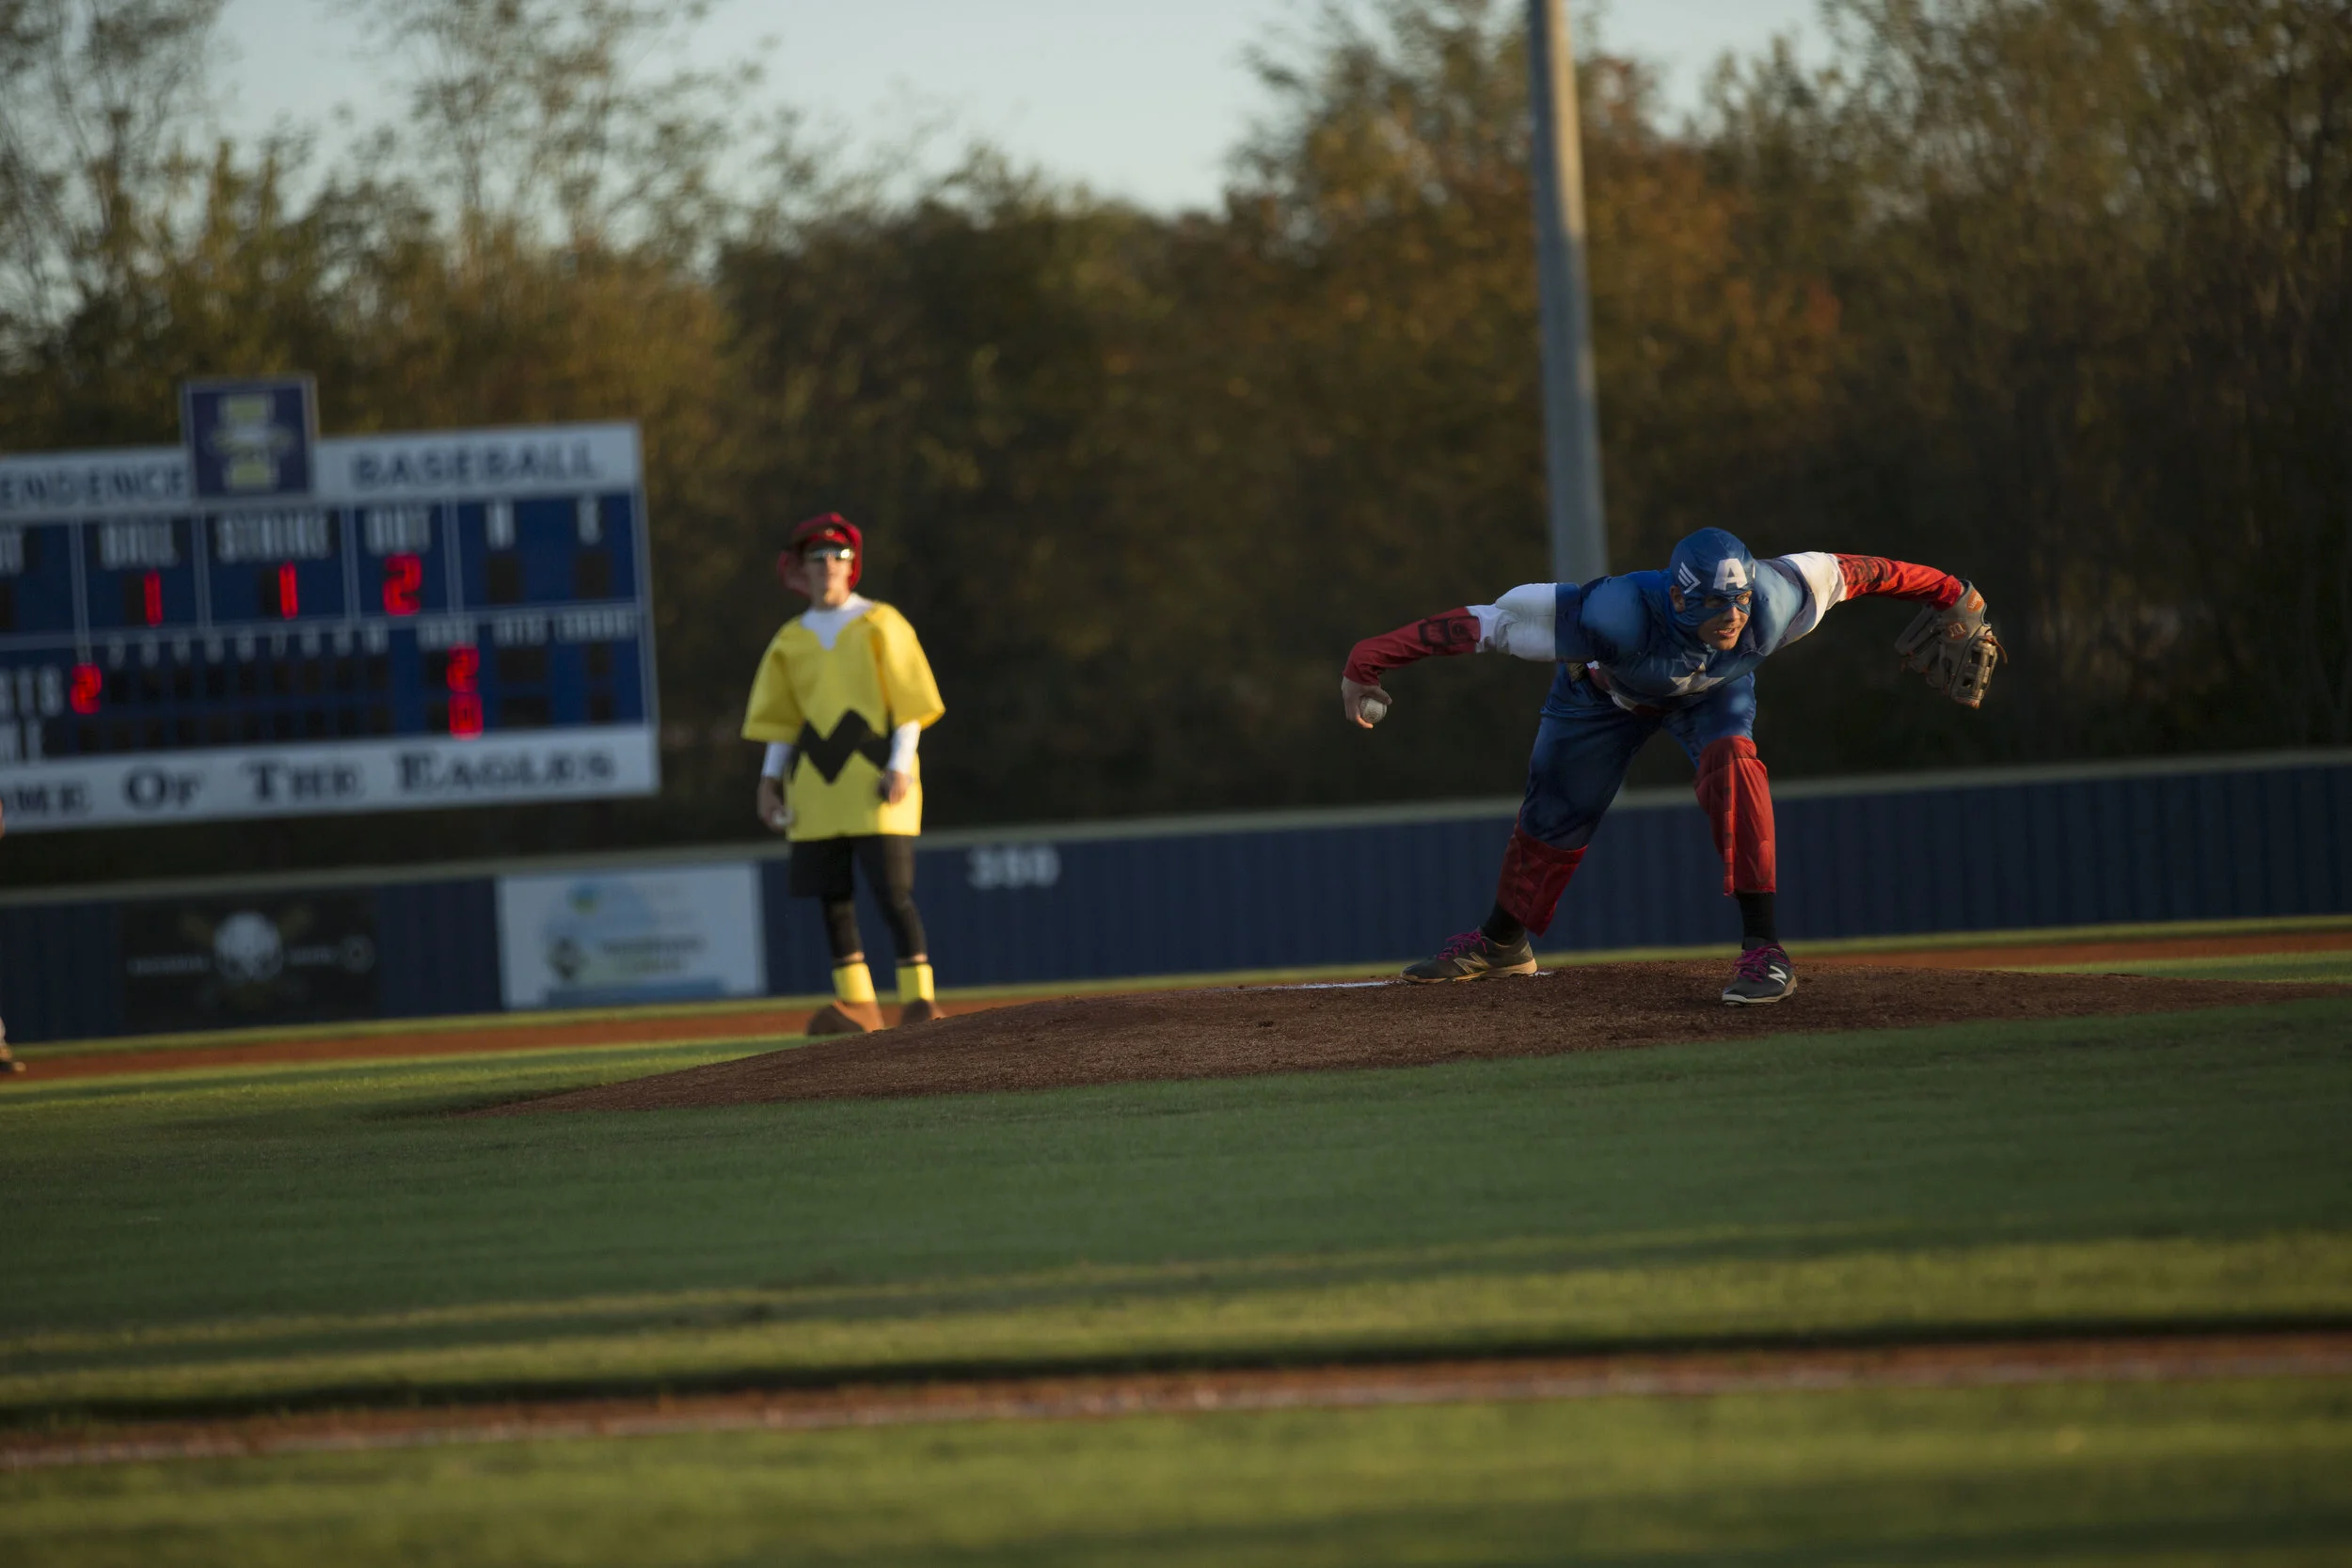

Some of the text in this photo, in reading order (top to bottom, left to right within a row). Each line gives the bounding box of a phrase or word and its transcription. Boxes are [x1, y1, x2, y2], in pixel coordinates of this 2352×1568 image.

[348, 439, 602, 491] BASEBALL
[143, 567, 163, 627] 1
[279, 561, 298, 620] 1
[382, 551, 421, 616] 2
[1712, 558, 1748, 591] A
[446, 641, 480, 692] 2
